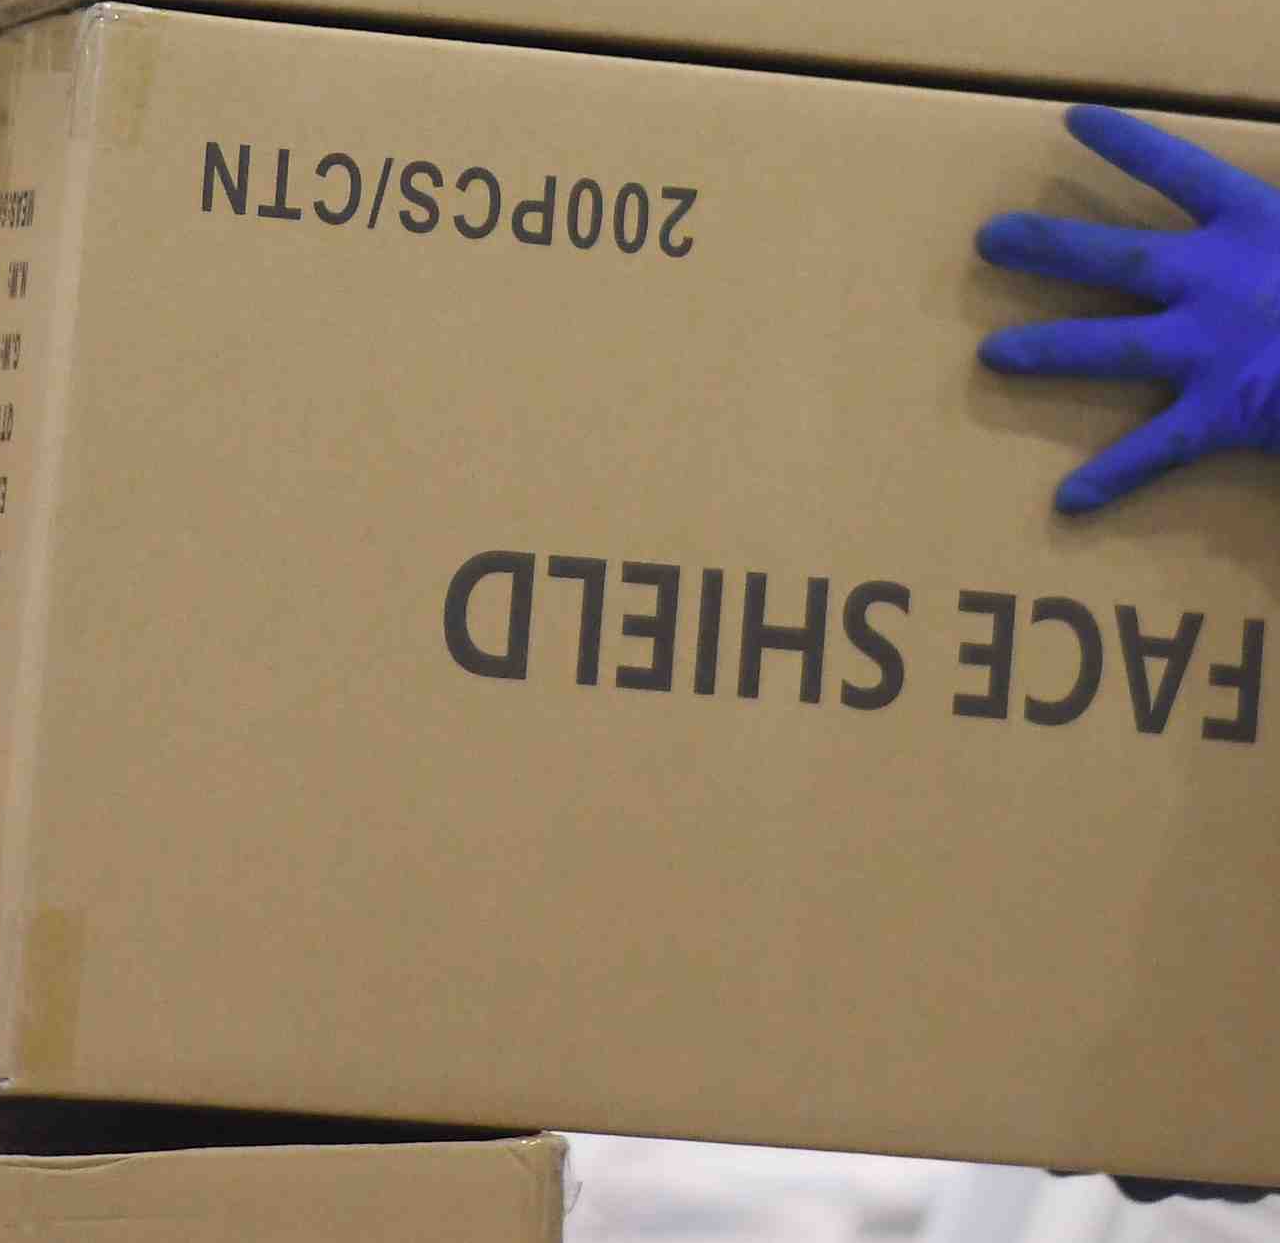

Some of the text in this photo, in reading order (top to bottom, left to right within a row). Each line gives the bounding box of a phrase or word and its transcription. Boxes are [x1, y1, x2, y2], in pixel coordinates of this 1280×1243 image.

[201, 141, 698, 258] 200PCS/CTN
[442, 548, 1266, 744] FACE SHIELD
